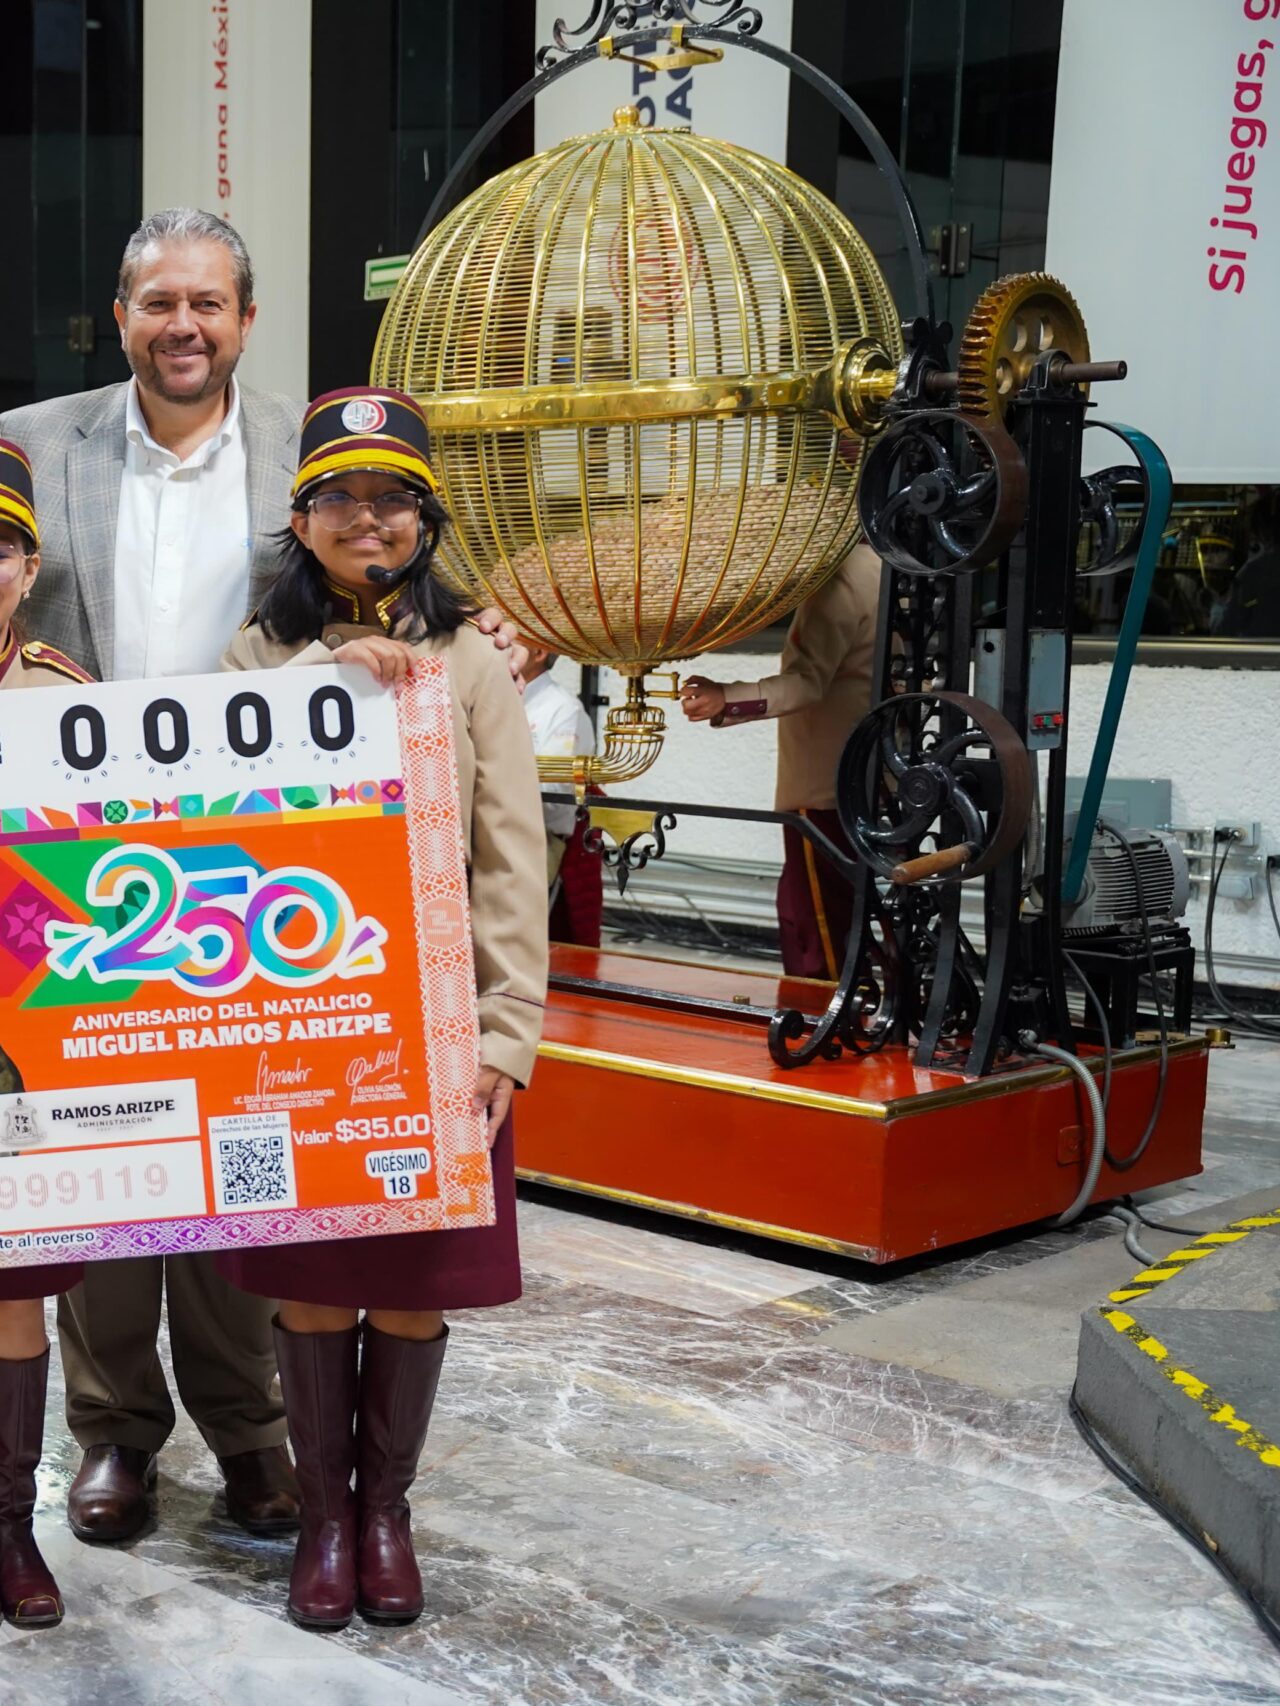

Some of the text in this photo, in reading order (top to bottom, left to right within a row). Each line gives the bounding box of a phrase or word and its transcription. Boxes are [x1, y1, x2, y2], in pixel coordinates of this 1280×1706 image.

[218, 105, 231, 199] gana
[1210, 39, 1274, 240] juegas,
[1207, 247, 1247, 294] Si
[87, 844, 355, 997] 250
[72, 992, 372, 1031] ANIVERSARIO DEL NATALICIO
[62, 1012, 393, 1060] MIGUEL RAMOS ARIZPE
[52, 1099, 175, 1121] RAMOS ARIZPE
[77, 1116, 153, 1128] ADMINISTRACIÓN
[222, 1116, 263, 1125] CARTILLA
[211, 1126, 241, 1134] Derechos
[263, 1122, 288, 1131] Mujeres
[293, 1113, 431, 1146] Valor $35.00
[369, 1151, 428, 1173] VIGÉSIMO
[388, 1176, 410, 1195] 18
[18, 1234, 34, 1248] al
[36, 1231, 95, 1246] reverso
